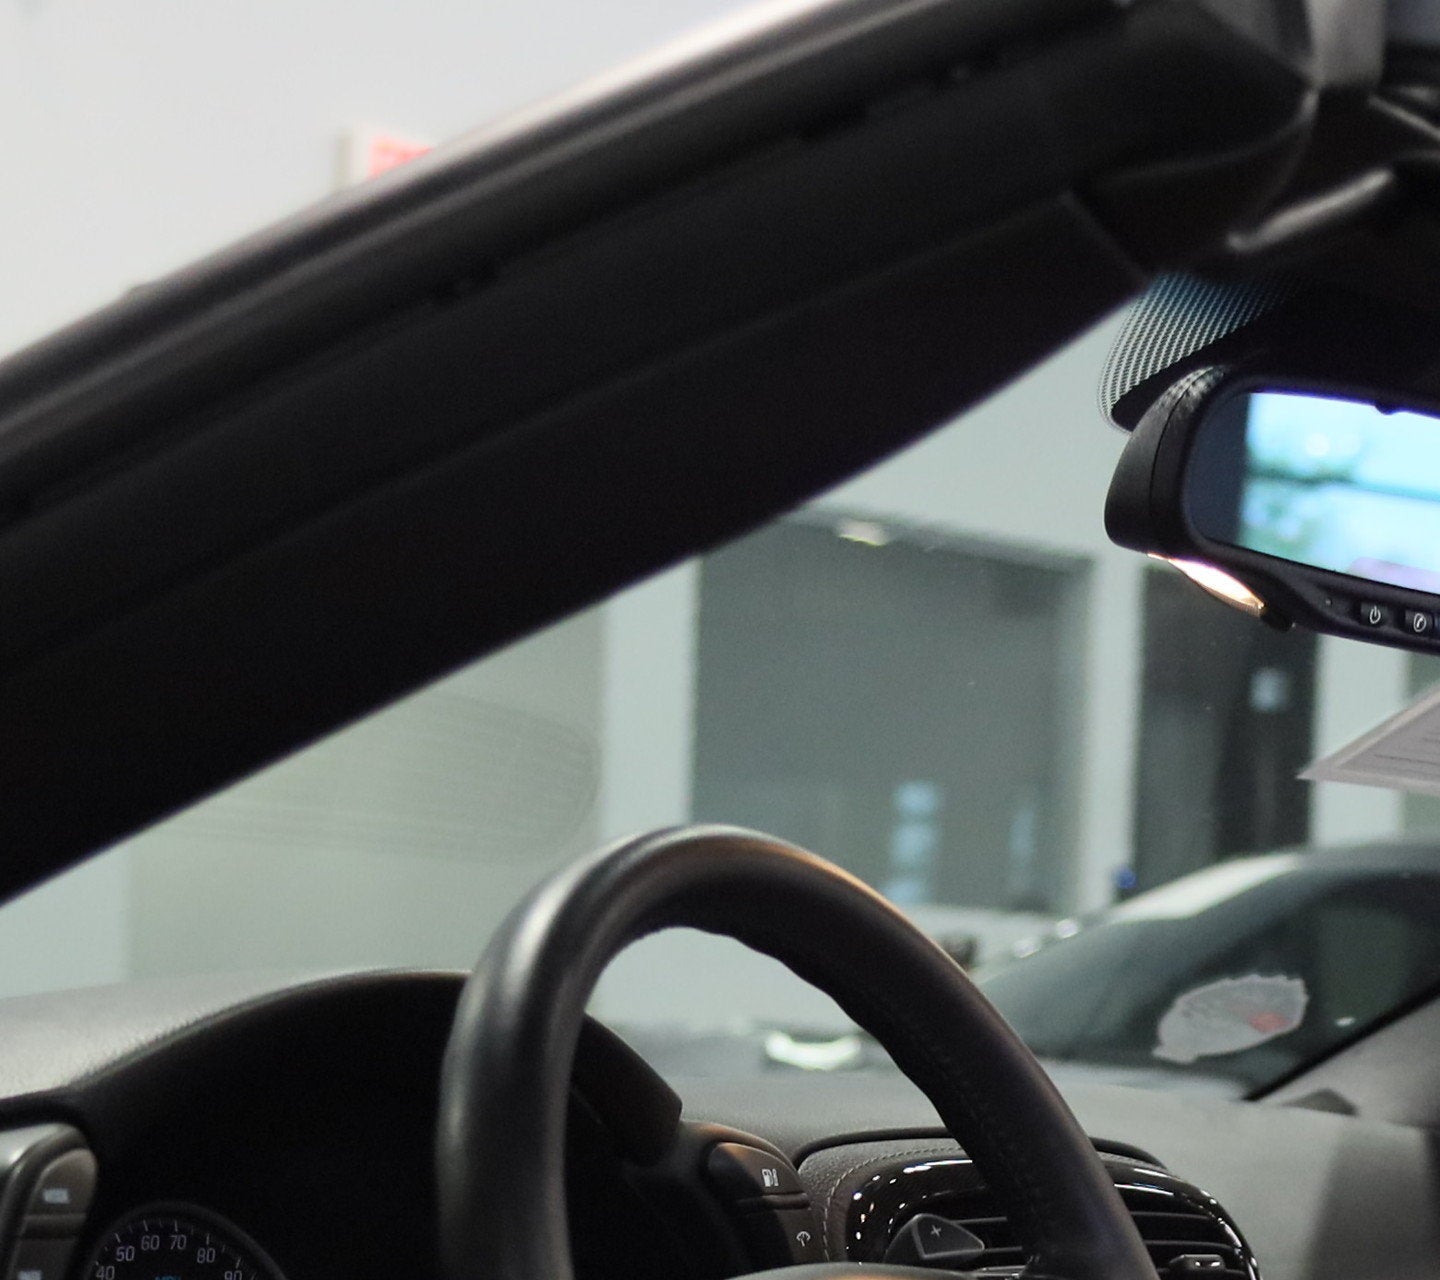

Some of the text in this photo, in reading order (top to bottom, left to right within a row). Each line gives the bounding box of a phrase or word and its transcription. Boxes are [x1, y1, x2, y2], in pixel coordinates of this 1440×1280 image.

[141, 1234, 160, 1251] 60
[169, 1234, 187, 1251] 70
[115, 1245, 136, 1263] 50
[196, 1247, 216, 1264] 80
